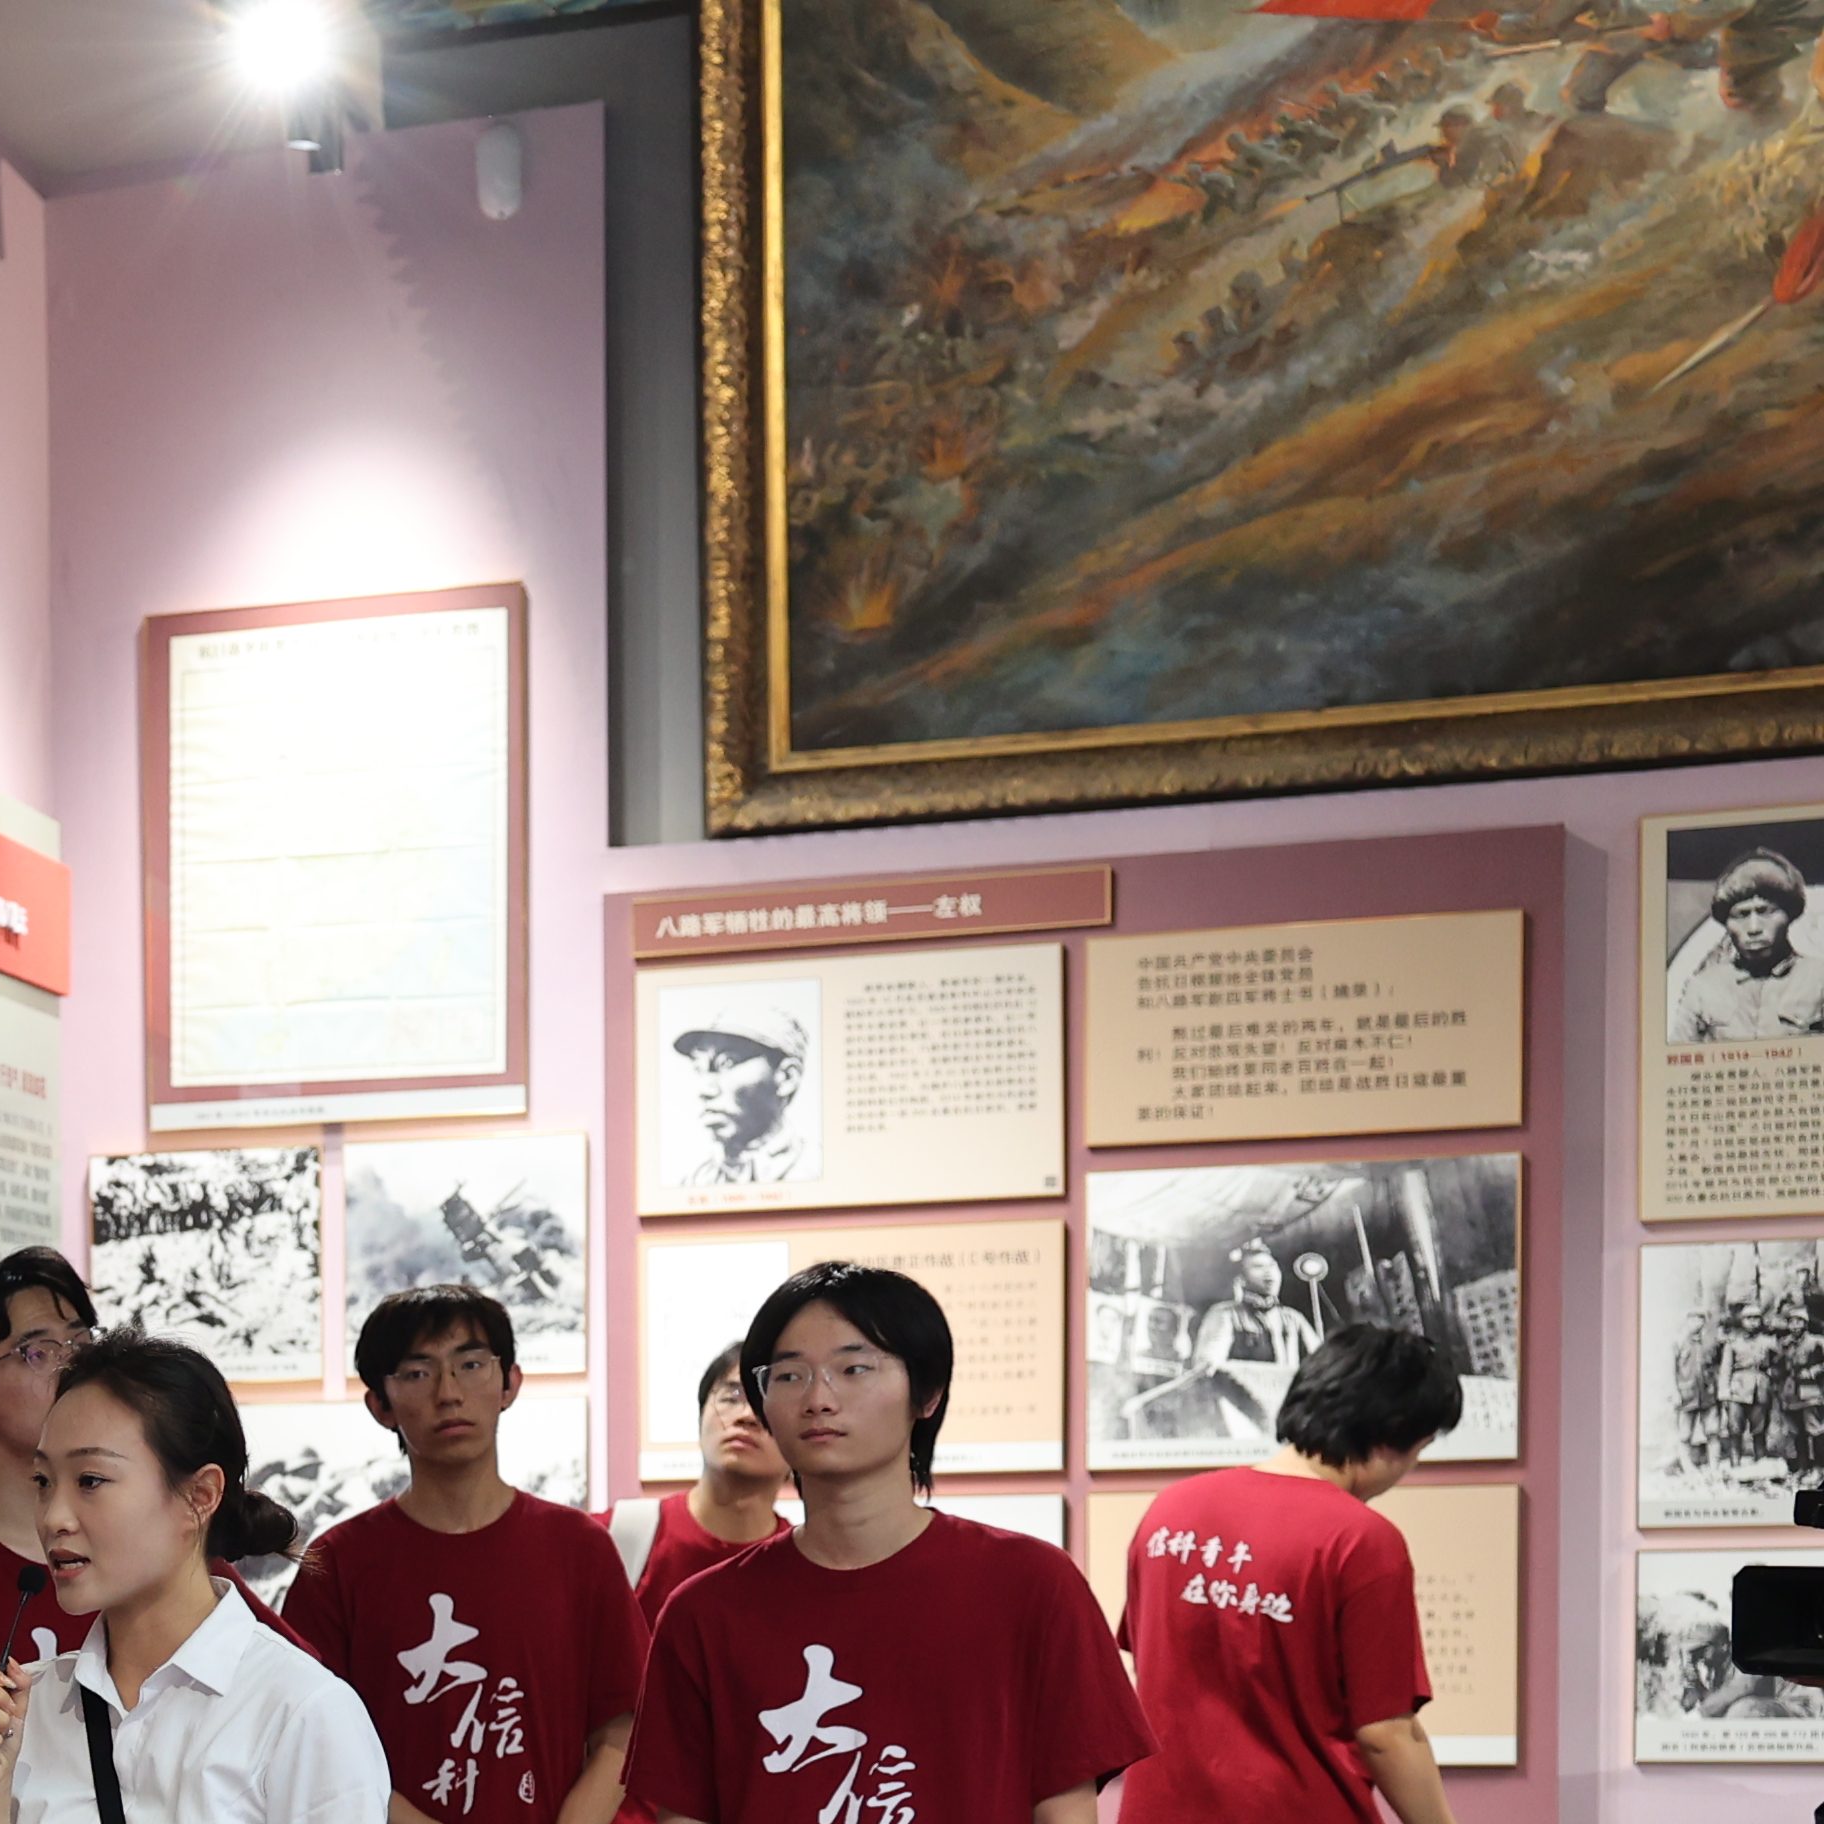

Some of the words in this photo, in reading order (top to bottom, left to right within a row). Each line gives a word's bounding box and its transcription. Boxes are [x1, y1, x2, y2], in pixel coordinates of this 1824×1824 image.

[1147, 1526, 1252, 1574] 信科青年
[1181, 1573, 1294, 1623] 在你身边
